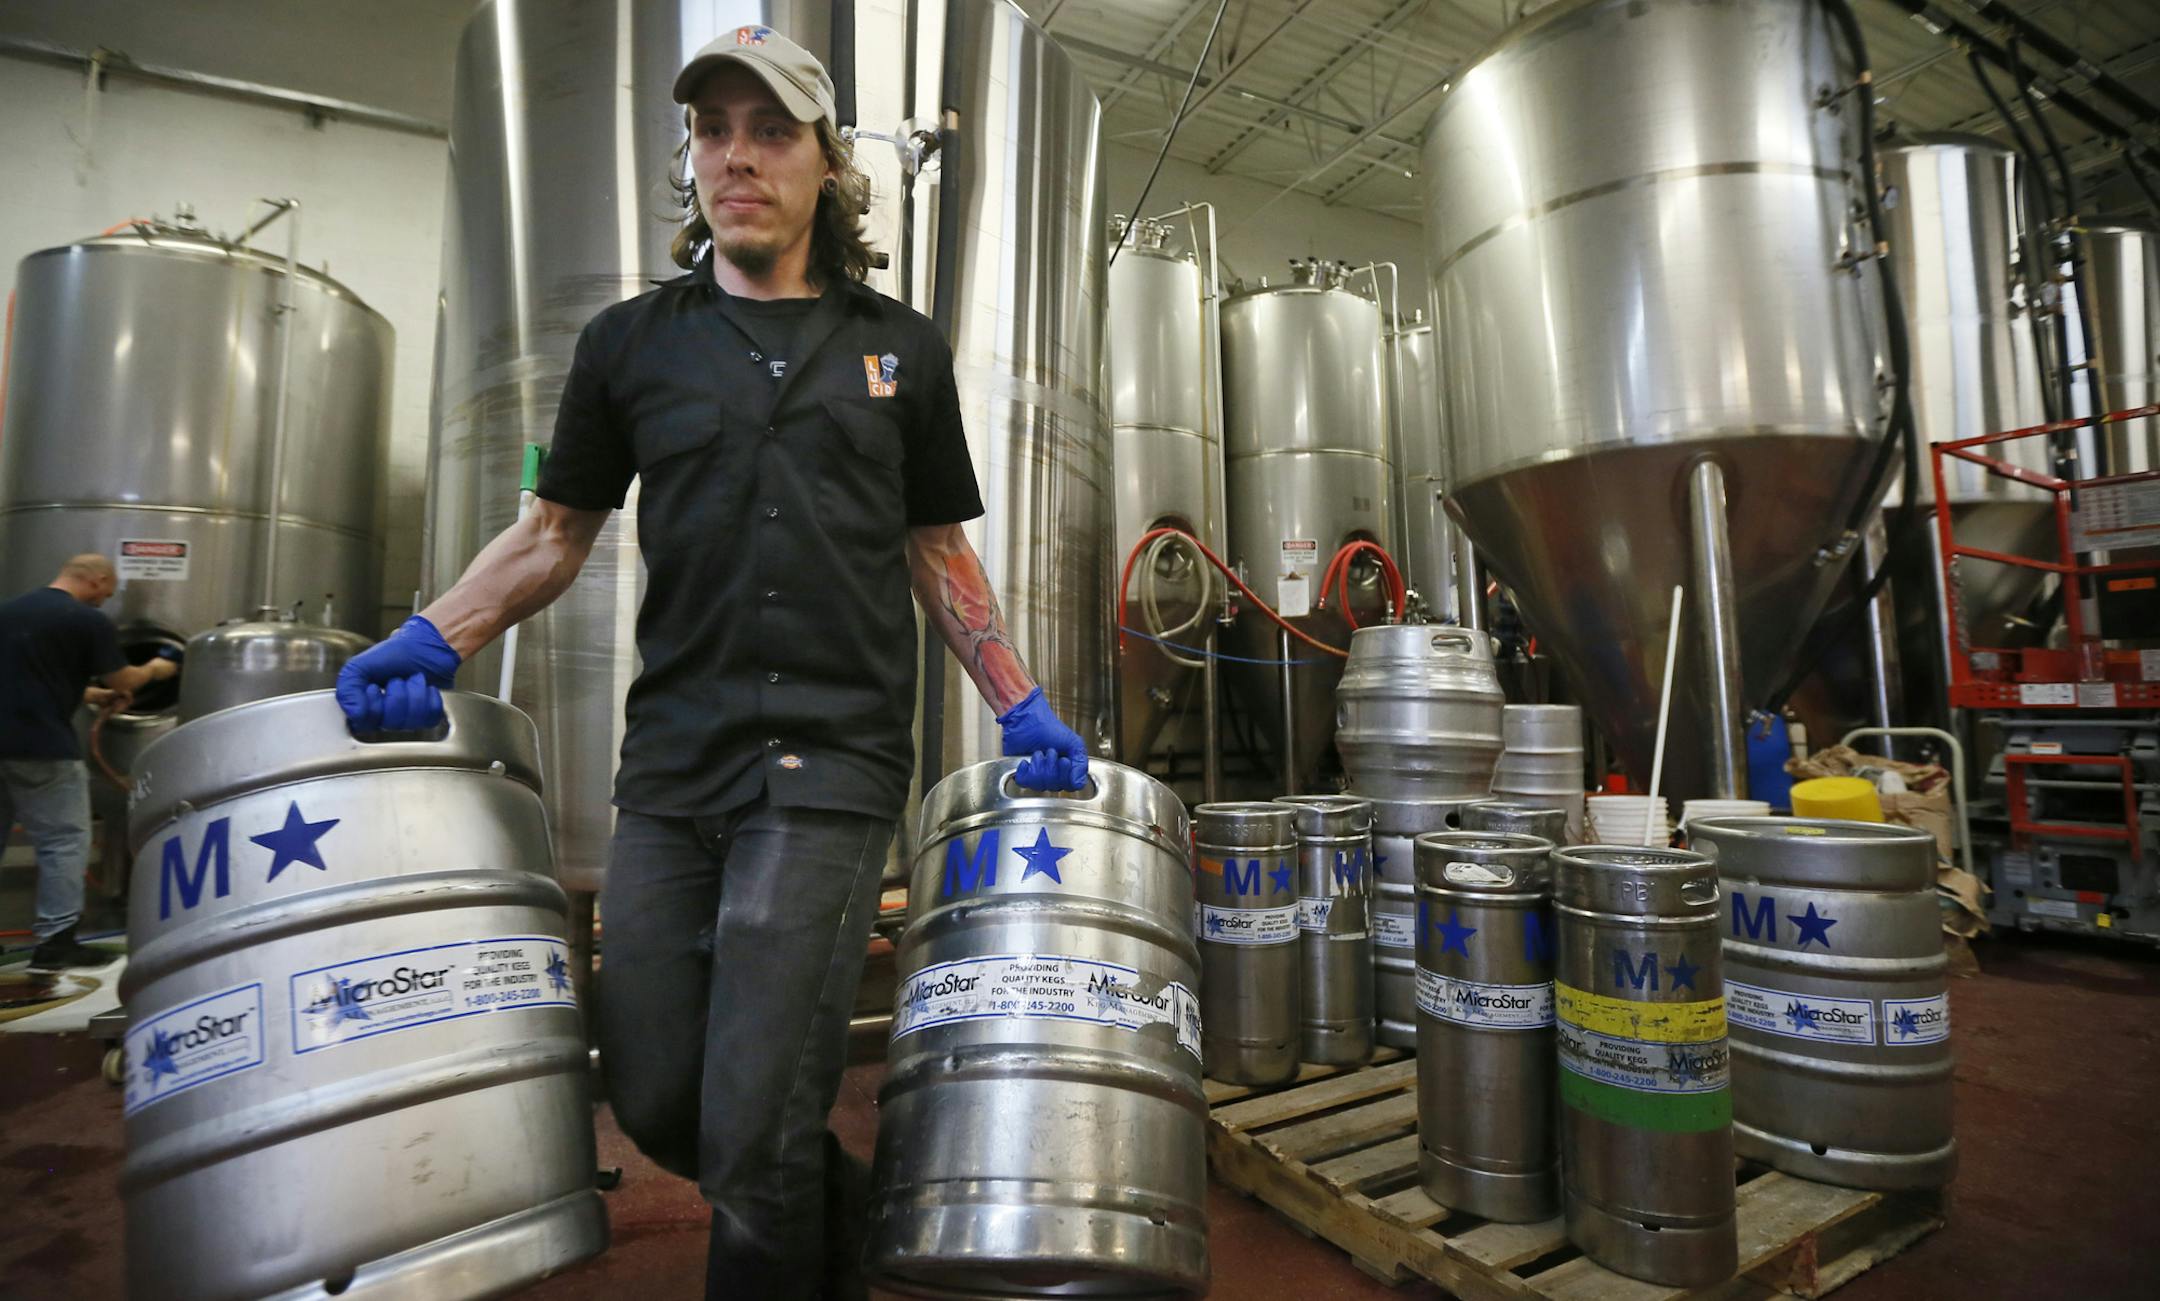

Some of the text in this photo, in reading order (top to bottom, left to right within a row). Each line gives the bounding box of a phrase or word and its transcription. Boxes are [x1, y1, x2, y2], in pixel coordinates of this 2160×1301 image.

[160, 816, 231, 922] M
[943, 829, 999, 897] M
[1224, 859, 1260, 896] M
[1732, 892, 1777, 942] M
[1042, 976, 1066, 984] KEGS
[1614, 951, 1659, 993] M
[908, 973, 980, 1003] MicroStar
[1030, 987, 1074, 997] INDUSTRY
[1456, 988, 1532, 1009] MicroStar
[1787, 1002, 1863, 1024] MicroStar
[1594, 1048, 1648, 1065] QUALITY KEGS
[1600, 1041, 1641, 1054] PROVIDING
[1589, 1066, 1658, 1087] 1-800-245-2200
